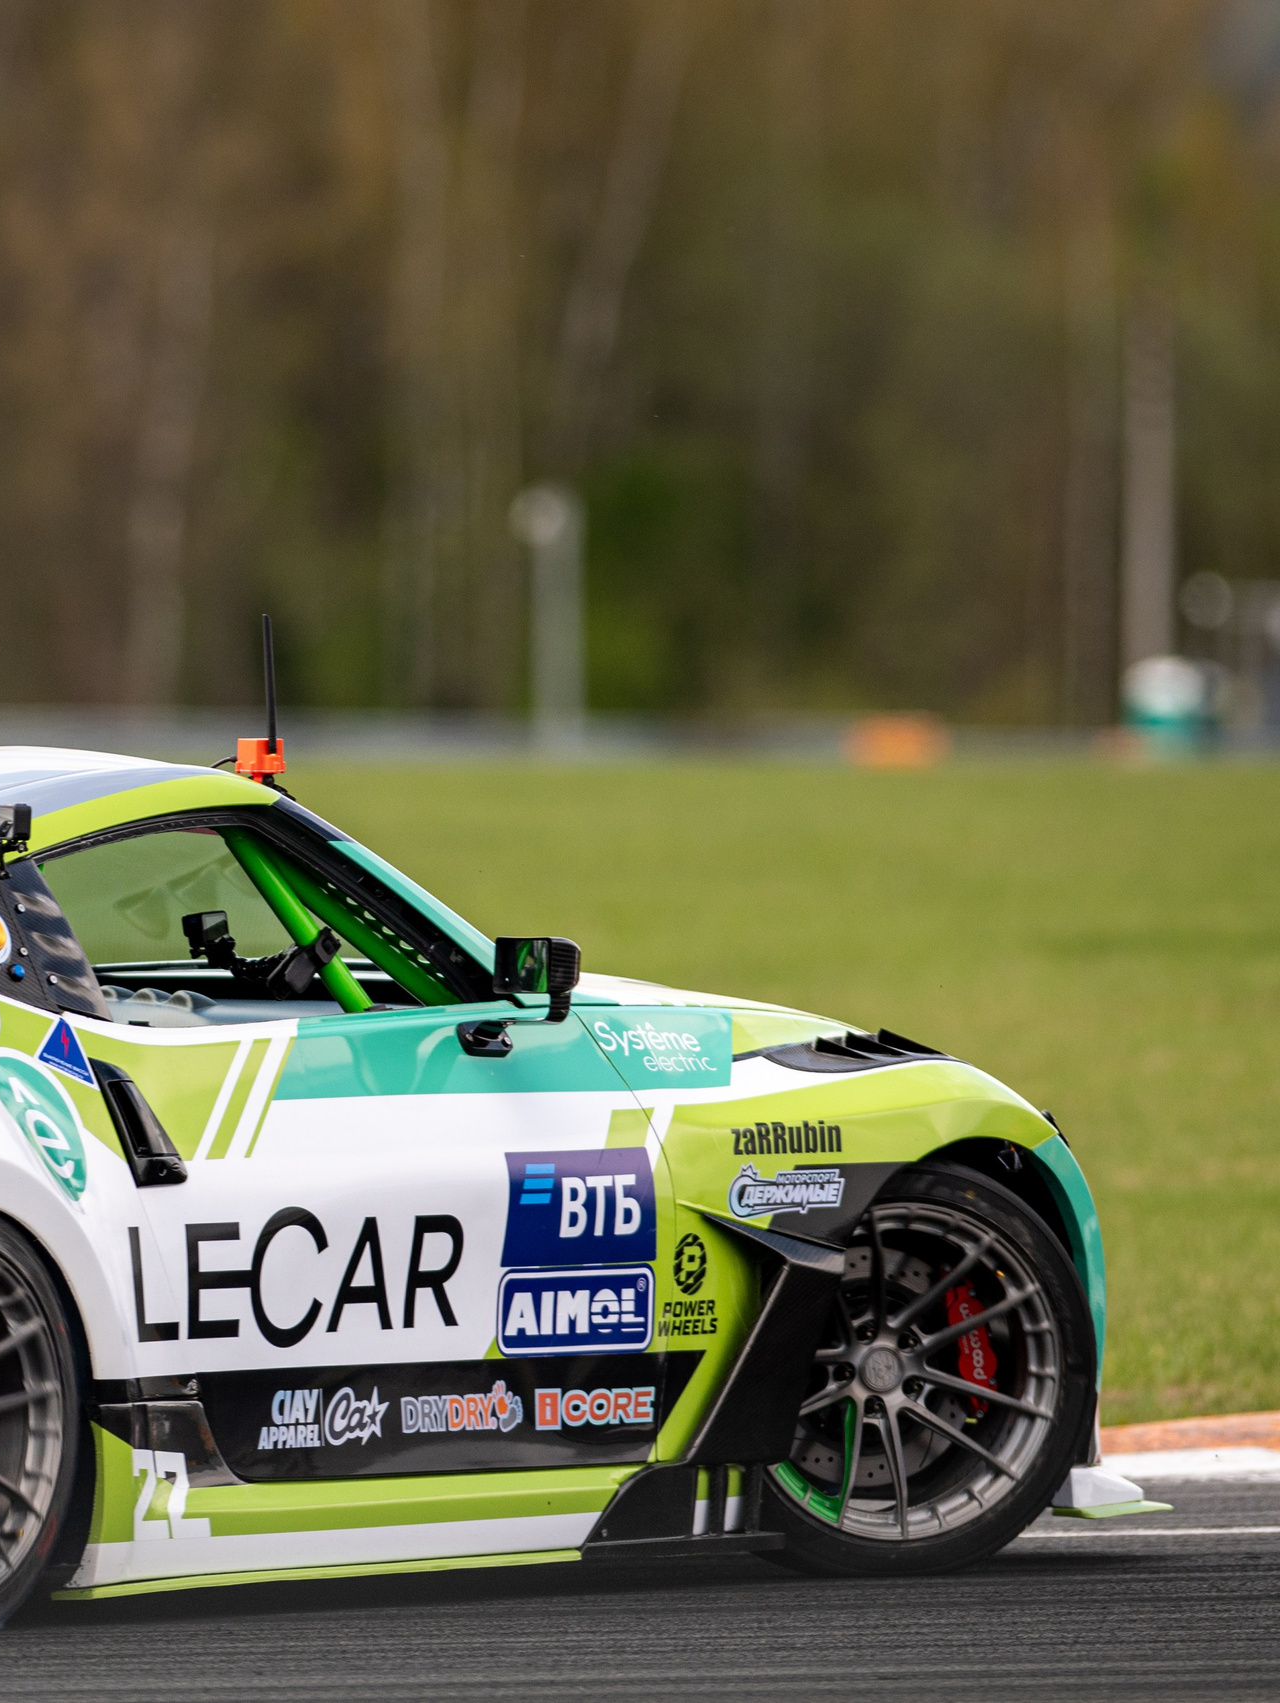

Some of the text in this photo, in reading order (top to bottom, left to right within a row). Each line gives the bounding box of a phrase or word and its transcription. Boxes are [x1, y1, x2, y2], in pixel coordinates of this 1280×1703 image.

[592, 1021, 702, 1056] Systême
[642, 1050, 718, 1073] electric
[730, 1119, 843, 1156] zaRRubin
[776, 1172, 835, 1184] МОТОРСПОРТ
[558, 1173, 642, 1239] ВТБ
[127, 1205, 465, 1349] LECAR
[503, 1288, 646, 1337] AIMOL
[657, 1315, 718, 1337] WHEELS
[662, 1298, 716, 1319] POWER
[257, 1424, 322, 1451] APPAREL
[131, 1447, 212, 1542] 22
